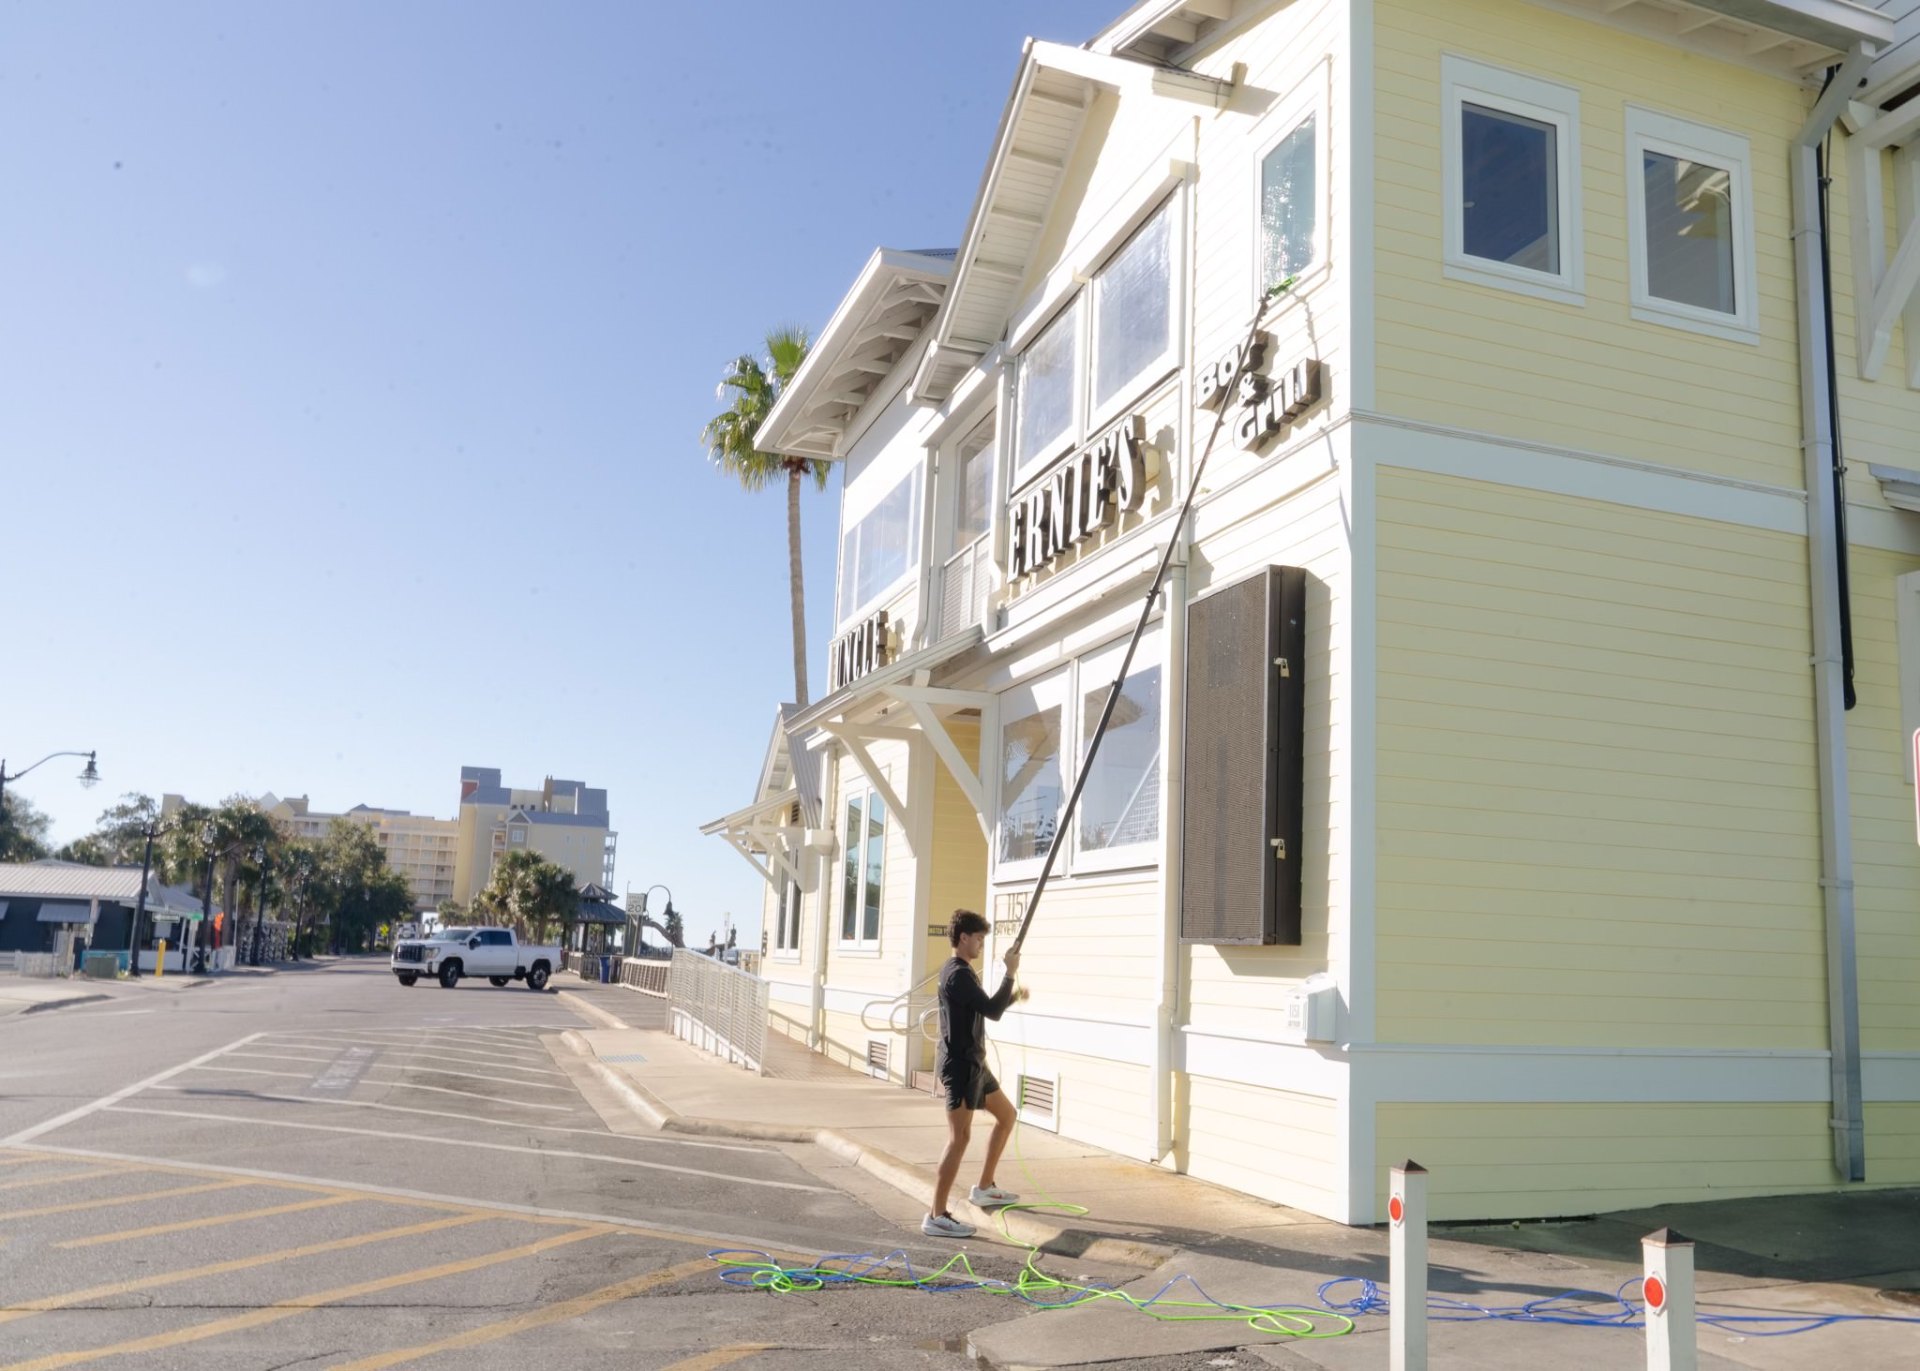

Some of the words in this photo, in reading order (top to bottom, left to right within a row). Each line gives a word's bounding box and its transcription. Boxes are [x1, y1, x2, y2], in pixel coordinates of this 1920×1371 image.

[1233, 358, 1313, 450] Grill
[1239, 371, 1260, 407] &
[1007, 415, 1142, 583] ERNIE'S
[834, 611, 884, 690] UNCLE
[628, 904, 641, 912] 20
